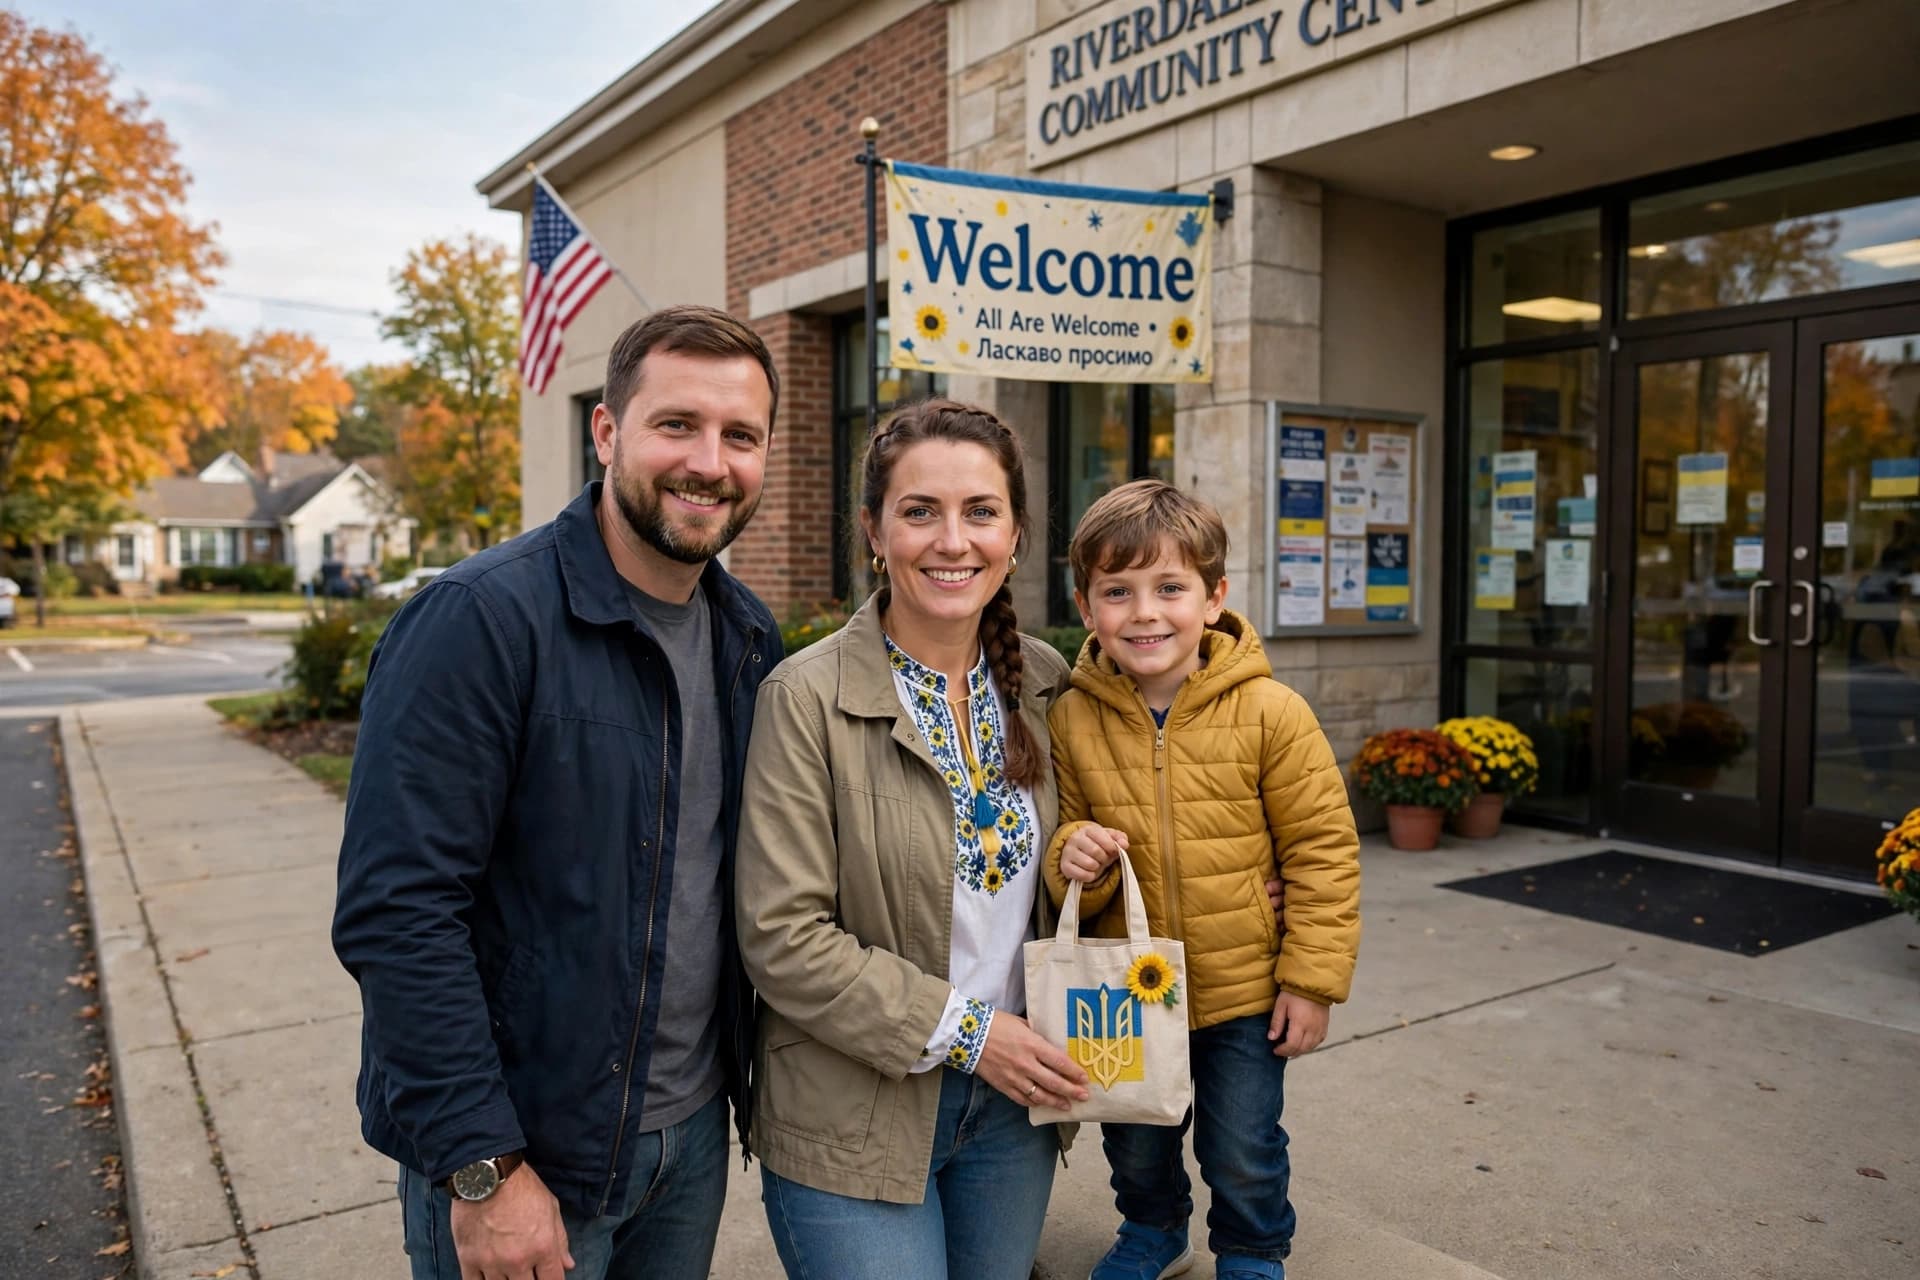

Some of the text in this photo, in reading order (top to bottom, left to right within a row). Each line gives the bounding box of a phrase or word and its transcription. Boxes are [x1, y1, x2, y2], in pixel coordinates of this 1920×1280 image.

[1039, 0, 1436, 146] COMMUNITY CE
[1049, 0, 1266, 90] RIVERDA
[908, 213, 1195, 303] Welcome
[975, 307, 1140, 338] All Are Welcome
[976, 337, 1154, 370] Ласкаво просимо
